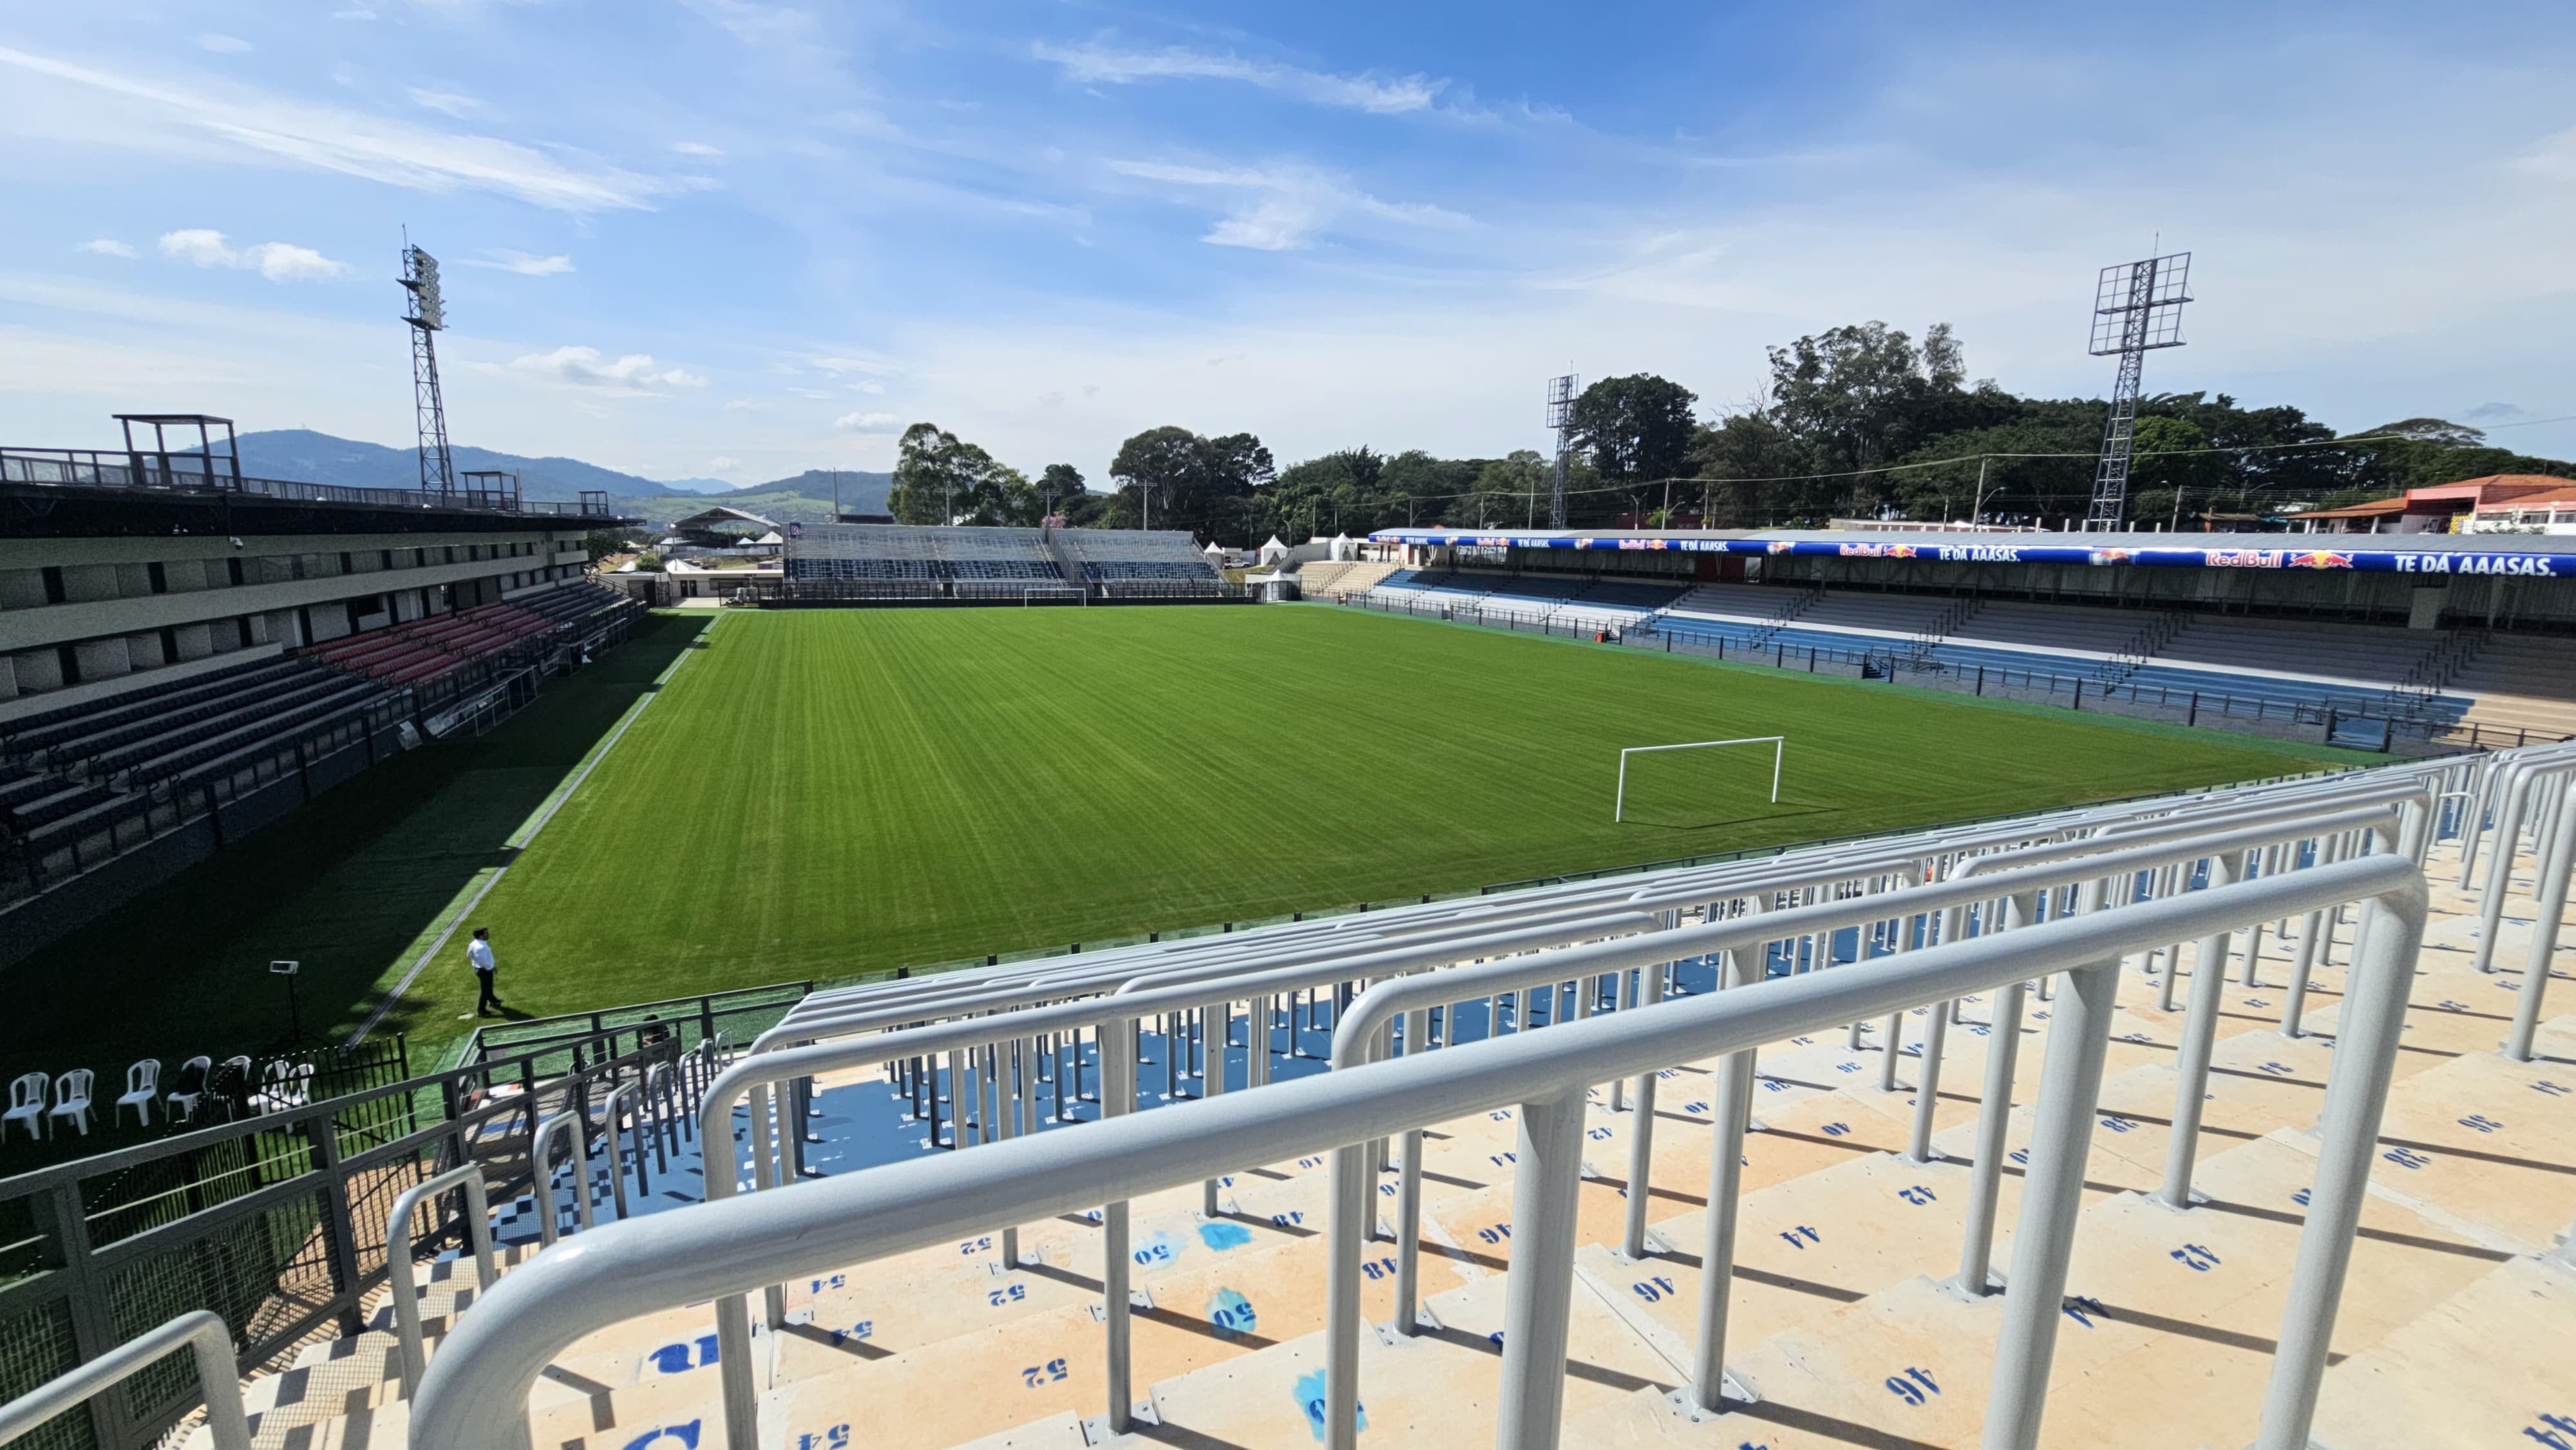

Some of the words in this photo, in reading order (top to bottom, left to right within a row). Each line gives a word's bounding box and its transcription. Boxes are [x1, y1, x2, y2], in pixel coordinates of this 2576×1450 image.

[1680, 540, 1690, 551] TE
[1938, 547, 1951, 561] TE
[2395, 555, 2416, 572] TE
[2458, 556, 2557, 576] AAASAS.
[1835, 1062, 1862, 1073] 36
[2257, 1062, 2295, 1077] 34
[1763, 1079, 1792, 1092] 38
[2528, 1080, 2573, 1097] 34
[1490, 1109, 1512, 1122] 42
[1684, 1101, 1710, 1113] 40
[1587, 1127, 1613, 1140] 42
[1821, 1122, 1852, 1136] 40
[2100, 1116, 2140, 1133] 38
[2457, 1115, 2505, 1133] 36
[1298, 1156, 1324, 1169] 46
[1489, 1152, 1517, 1167] 44
[2383, 1147, 2432, 1169] 38
[1899, 1185, 1937, 1206] 42
[1272, 1210, 1304, 1229] 48
[1478, 1223, 1511, 1244] 46
[1779, 1225, 1821, 1250] 44
[960, 1236, 991, 1255] 52
[1134, 1244, 1170, 1265] 50
[2170, 1243, 2222, 1272] 42
[1361, 1257, 1396, 1280] 48
[811, 1274, 846, 1294] 54
[1633, 1276, 1674, 1303] 46
[988, 1284, 1025, 1307] 52
[1213, 1302, 1256, 1329] 50
[2062, 1295, 2112, 1328] 44
[829, 1320, 873, 1346] 54
[1021, 1357, 1068, 1389] 52
[1885, 1366, 1942, 1407] 46
